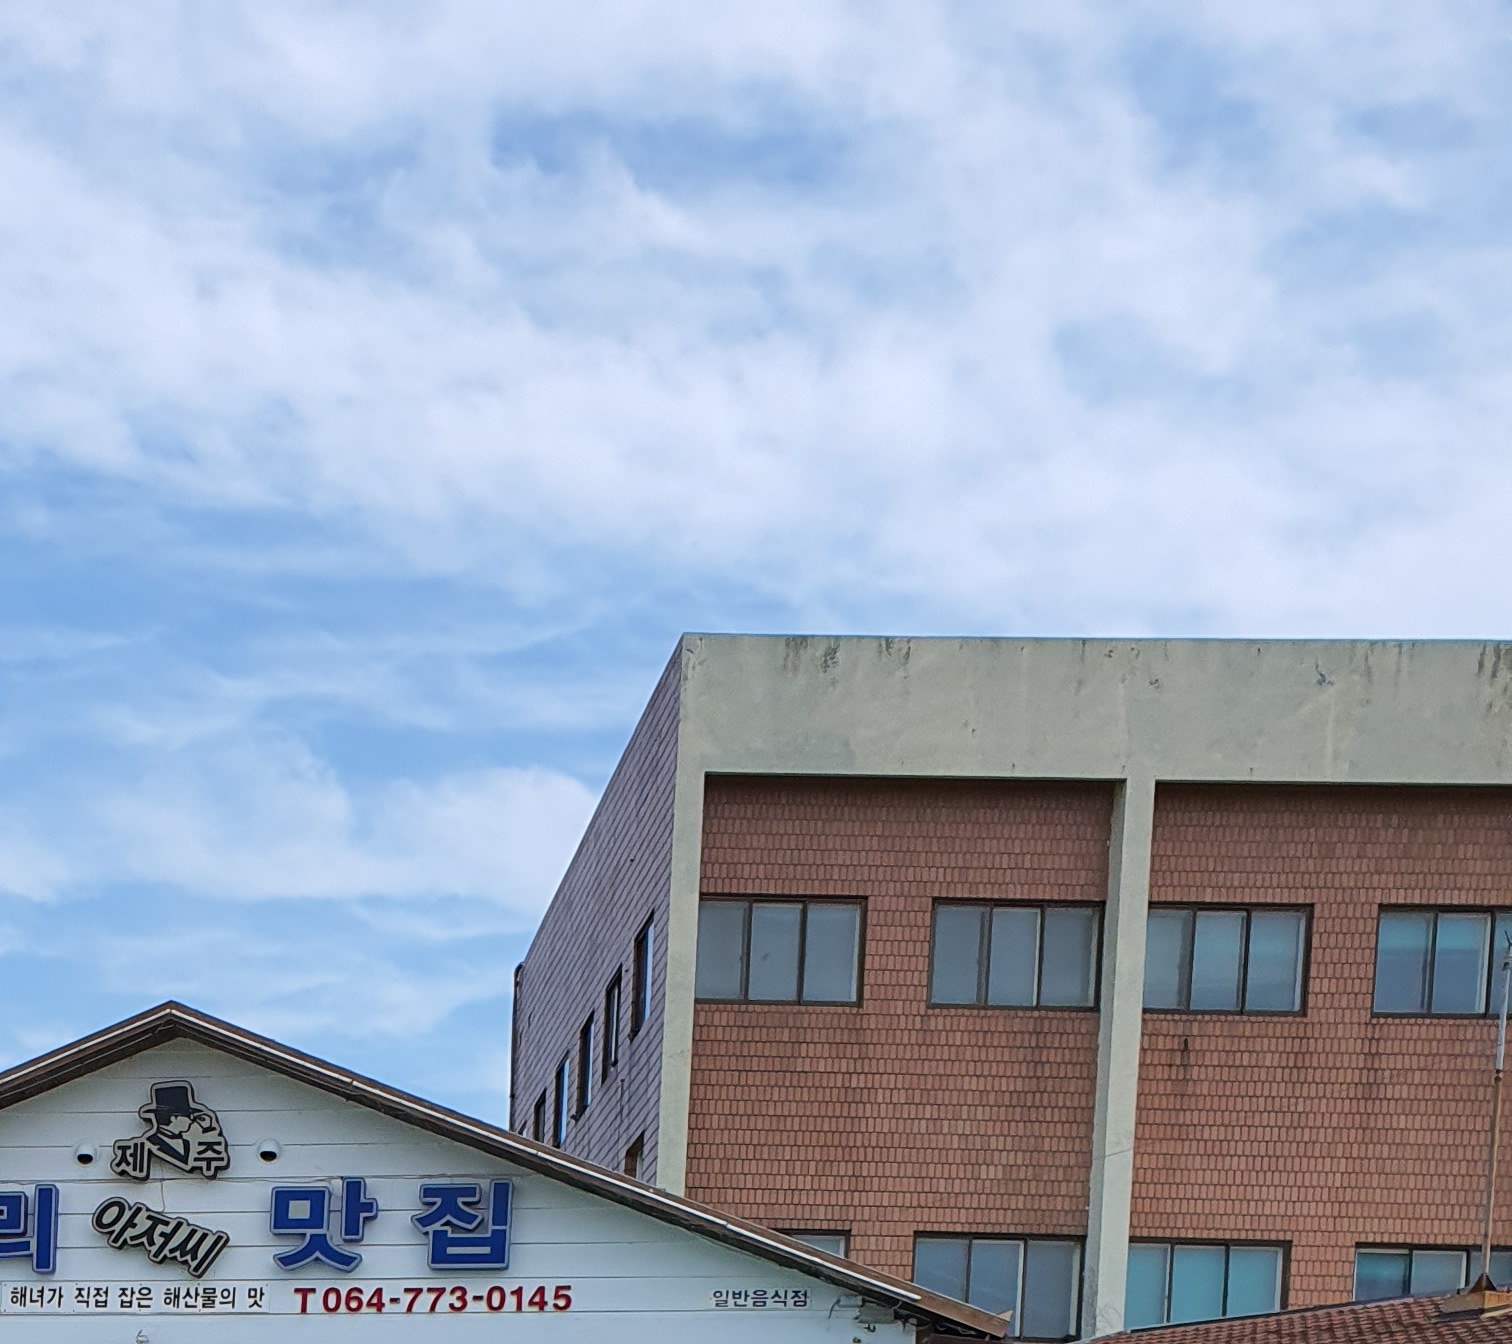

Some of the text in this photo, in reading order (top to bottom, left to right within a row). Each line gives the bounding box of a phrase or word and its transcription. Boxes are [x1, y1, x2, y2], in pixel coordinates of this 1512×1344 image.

[92, 1197, 230, 1279] 아저씨
[270, 1177, 514, 1273] 맛집
[9, 1285, 265, 1309] 해녀가 직접 잡은 해산물의 맛
[712, 1289, 809, 1308] 일반음식점
